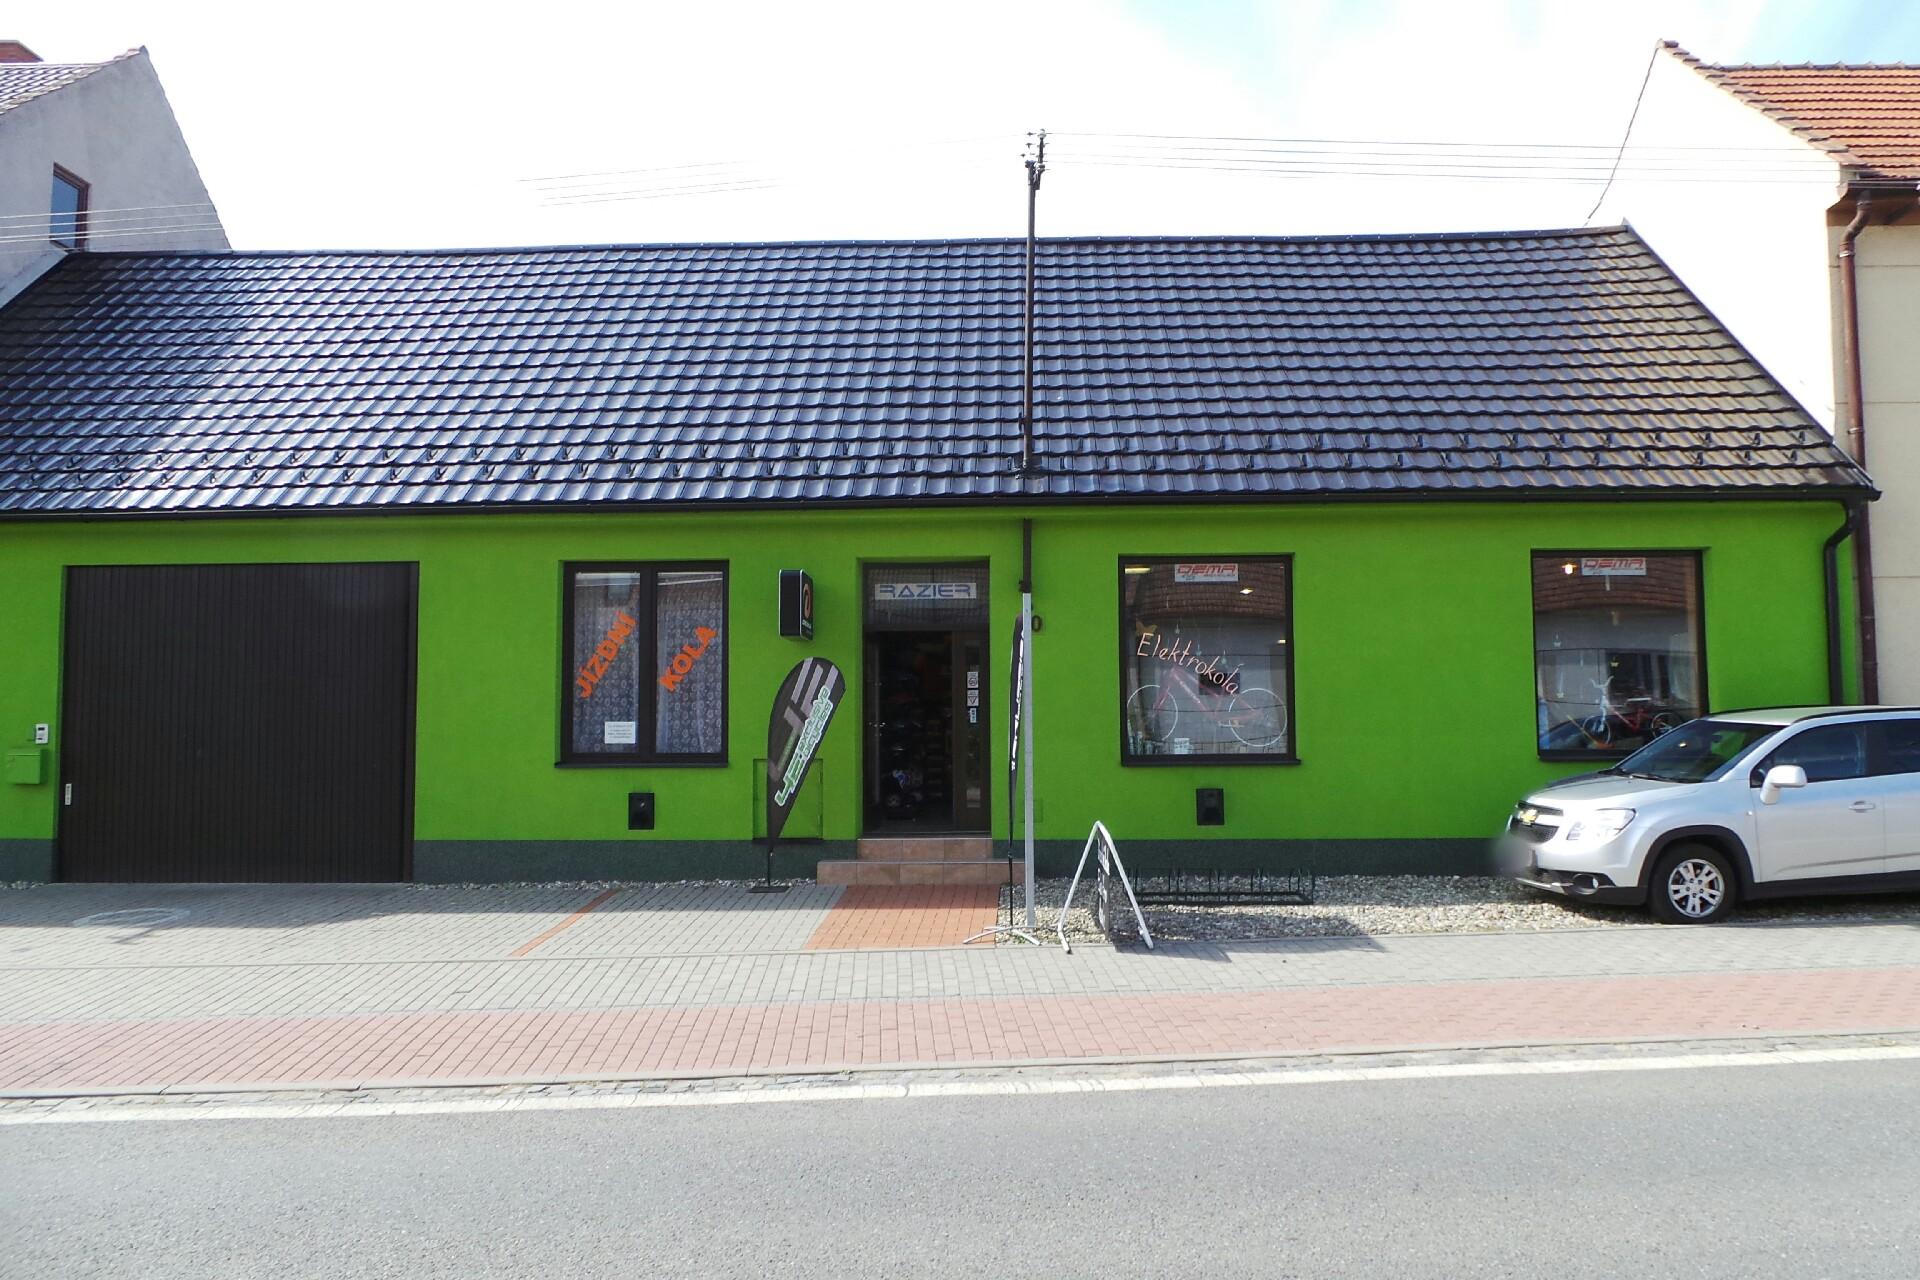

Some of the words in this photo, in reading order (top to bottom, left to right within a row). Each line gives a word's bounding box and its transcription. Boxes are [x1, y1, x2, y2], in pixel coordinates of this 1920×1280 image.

[880, 584, 971, 598] RAZIER
[659, 626, 717, 692] KOLA
[1137, 632, 1239, 695] Elektrokola
[798, 687, 830, 751] exclusive
